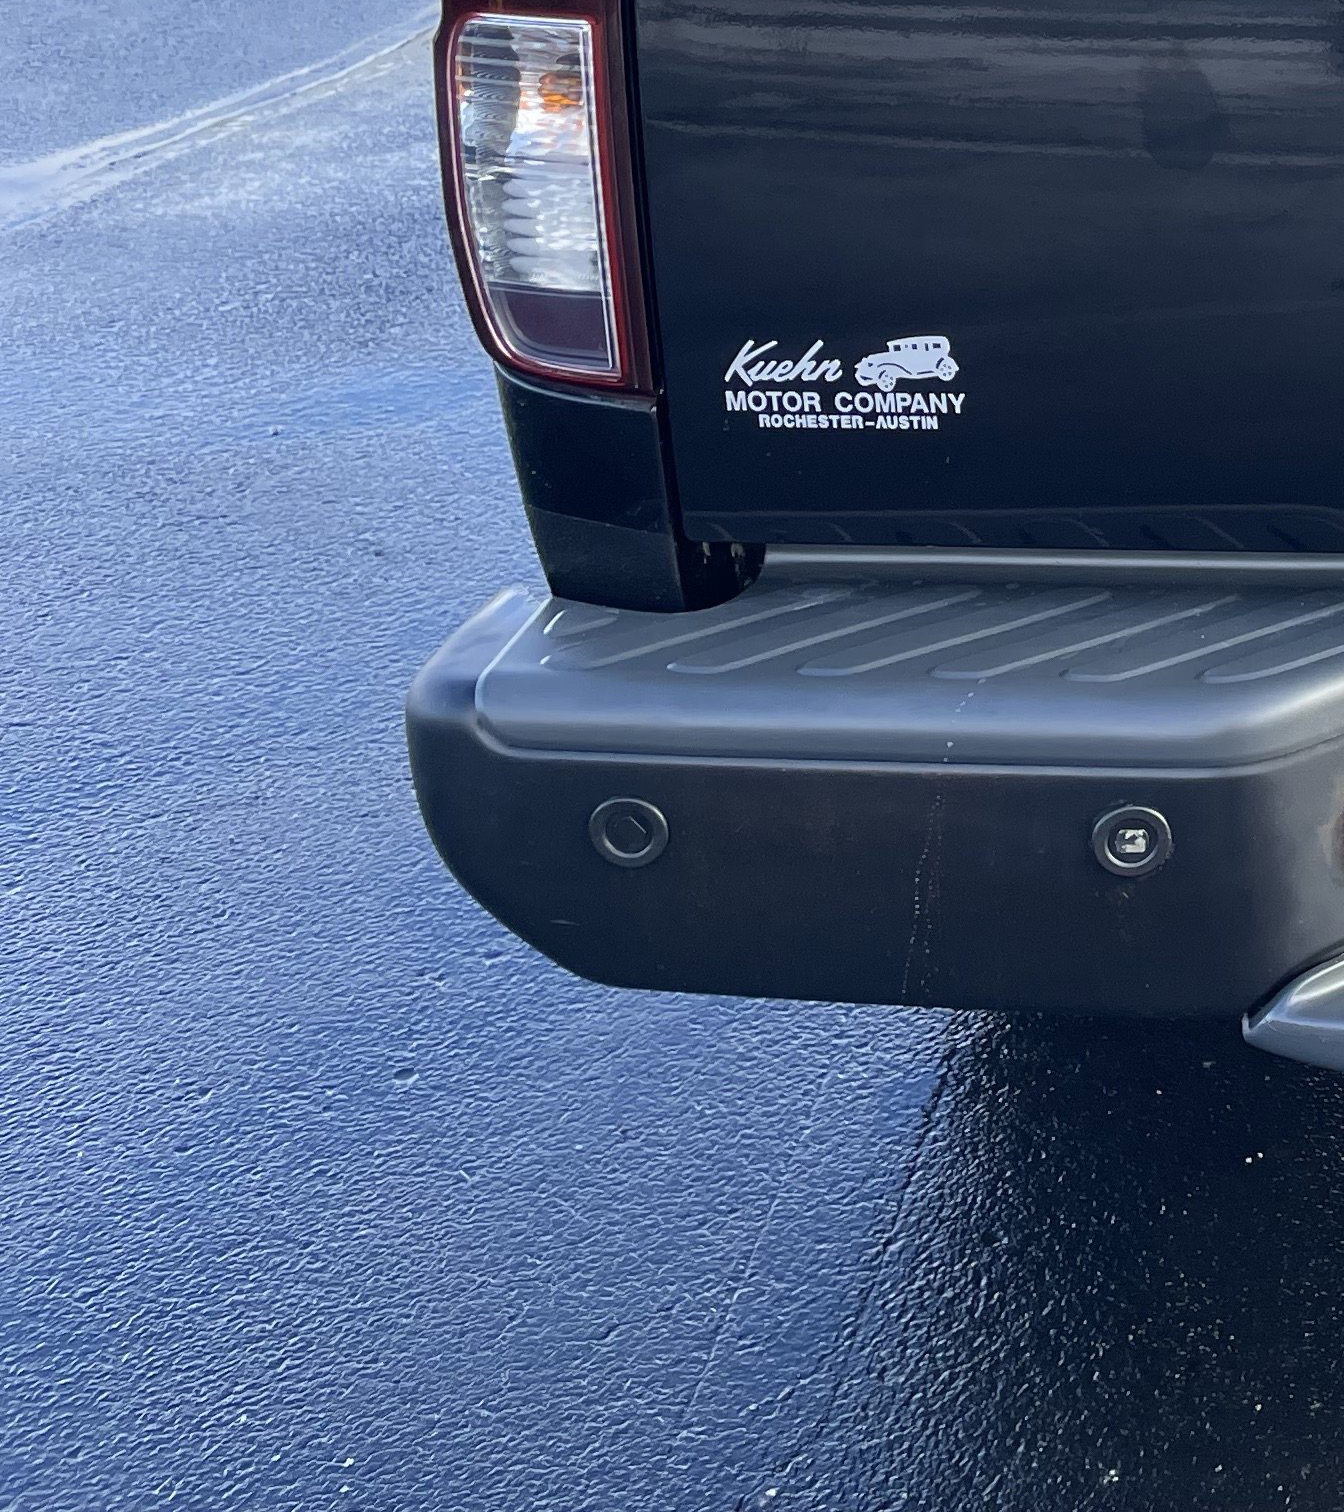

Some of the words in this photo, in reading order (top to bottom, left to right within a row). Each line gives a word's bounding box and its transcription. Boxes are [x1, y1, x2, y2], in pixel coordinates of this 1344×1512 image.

[724, 339, 843, 387] Kuehn
[725, 391, 822, 412] MOTOR
[834, 392, 966, 414] COMPANY
